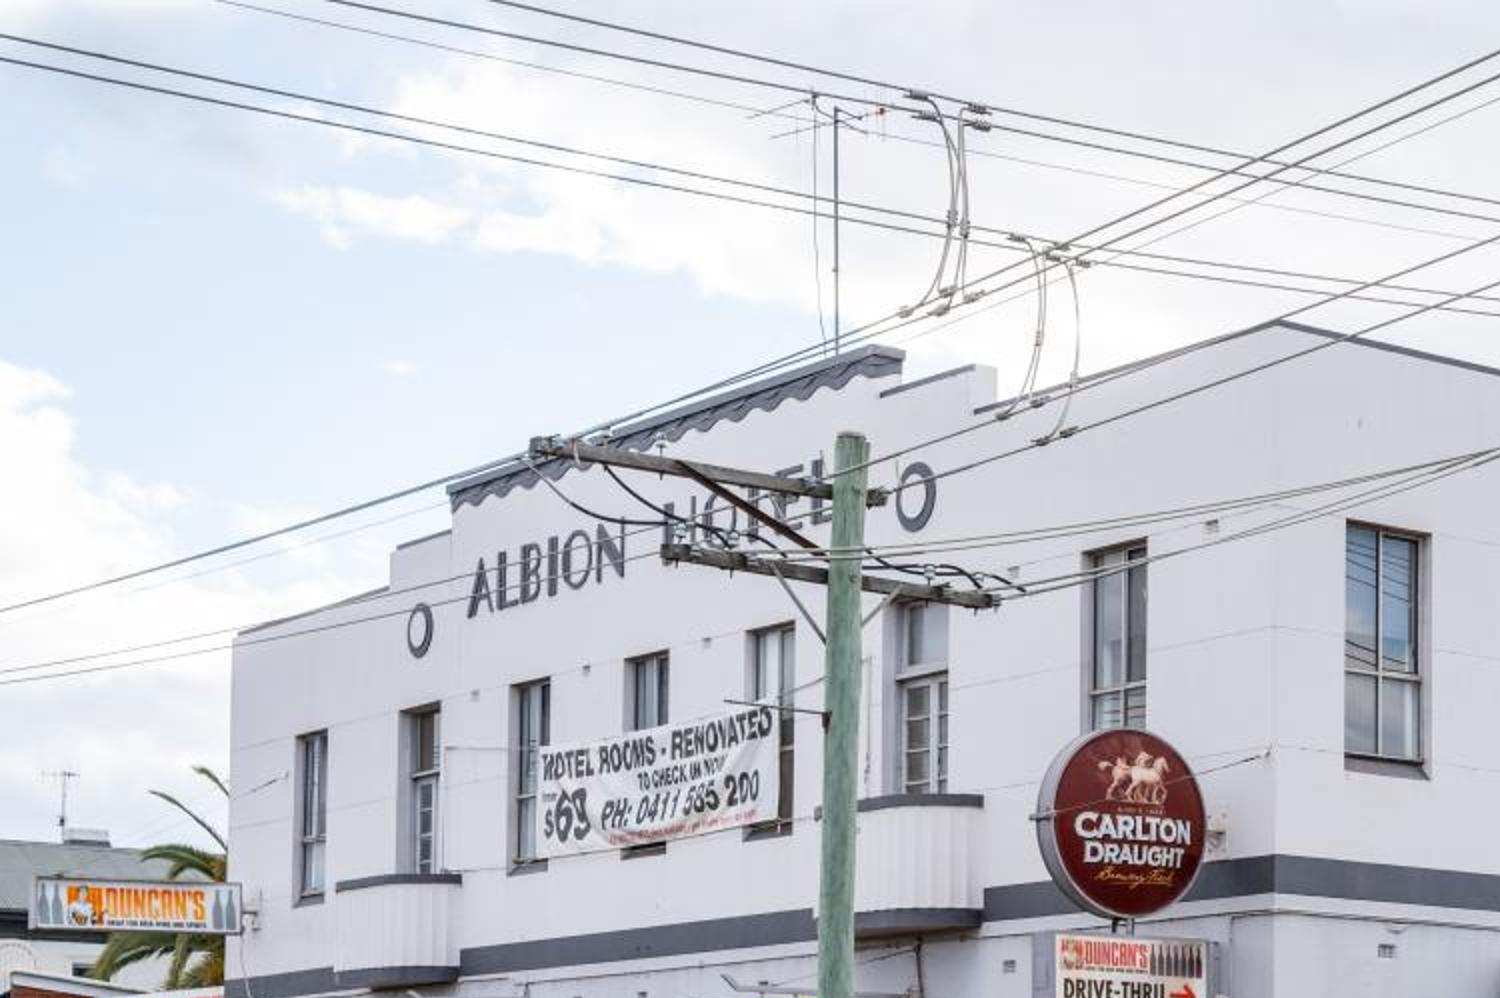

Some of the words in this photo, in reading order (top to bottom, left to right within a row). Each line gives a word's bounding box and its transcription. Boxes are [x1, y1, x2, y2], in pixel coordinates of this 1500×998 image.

[467, 518, 625, 619] ALBION
[599, 735, 656, 775] ROOMS
[671, 706, 773, 762] RENOVATED
[651, 763, 688, 788] CHECK
[543, 787, 591, 843] $69
[601, 797, 633, 831] PH:
[724, 768, 759, 807] 200
[1074, 811, 1191, 845] CARLTON
[1083, 840, 1185, 869] DRAUGHT
[105, 886, 206, 922] DUNCAN'S
[1084, 941, 1149, 969] DUNCAN'S
